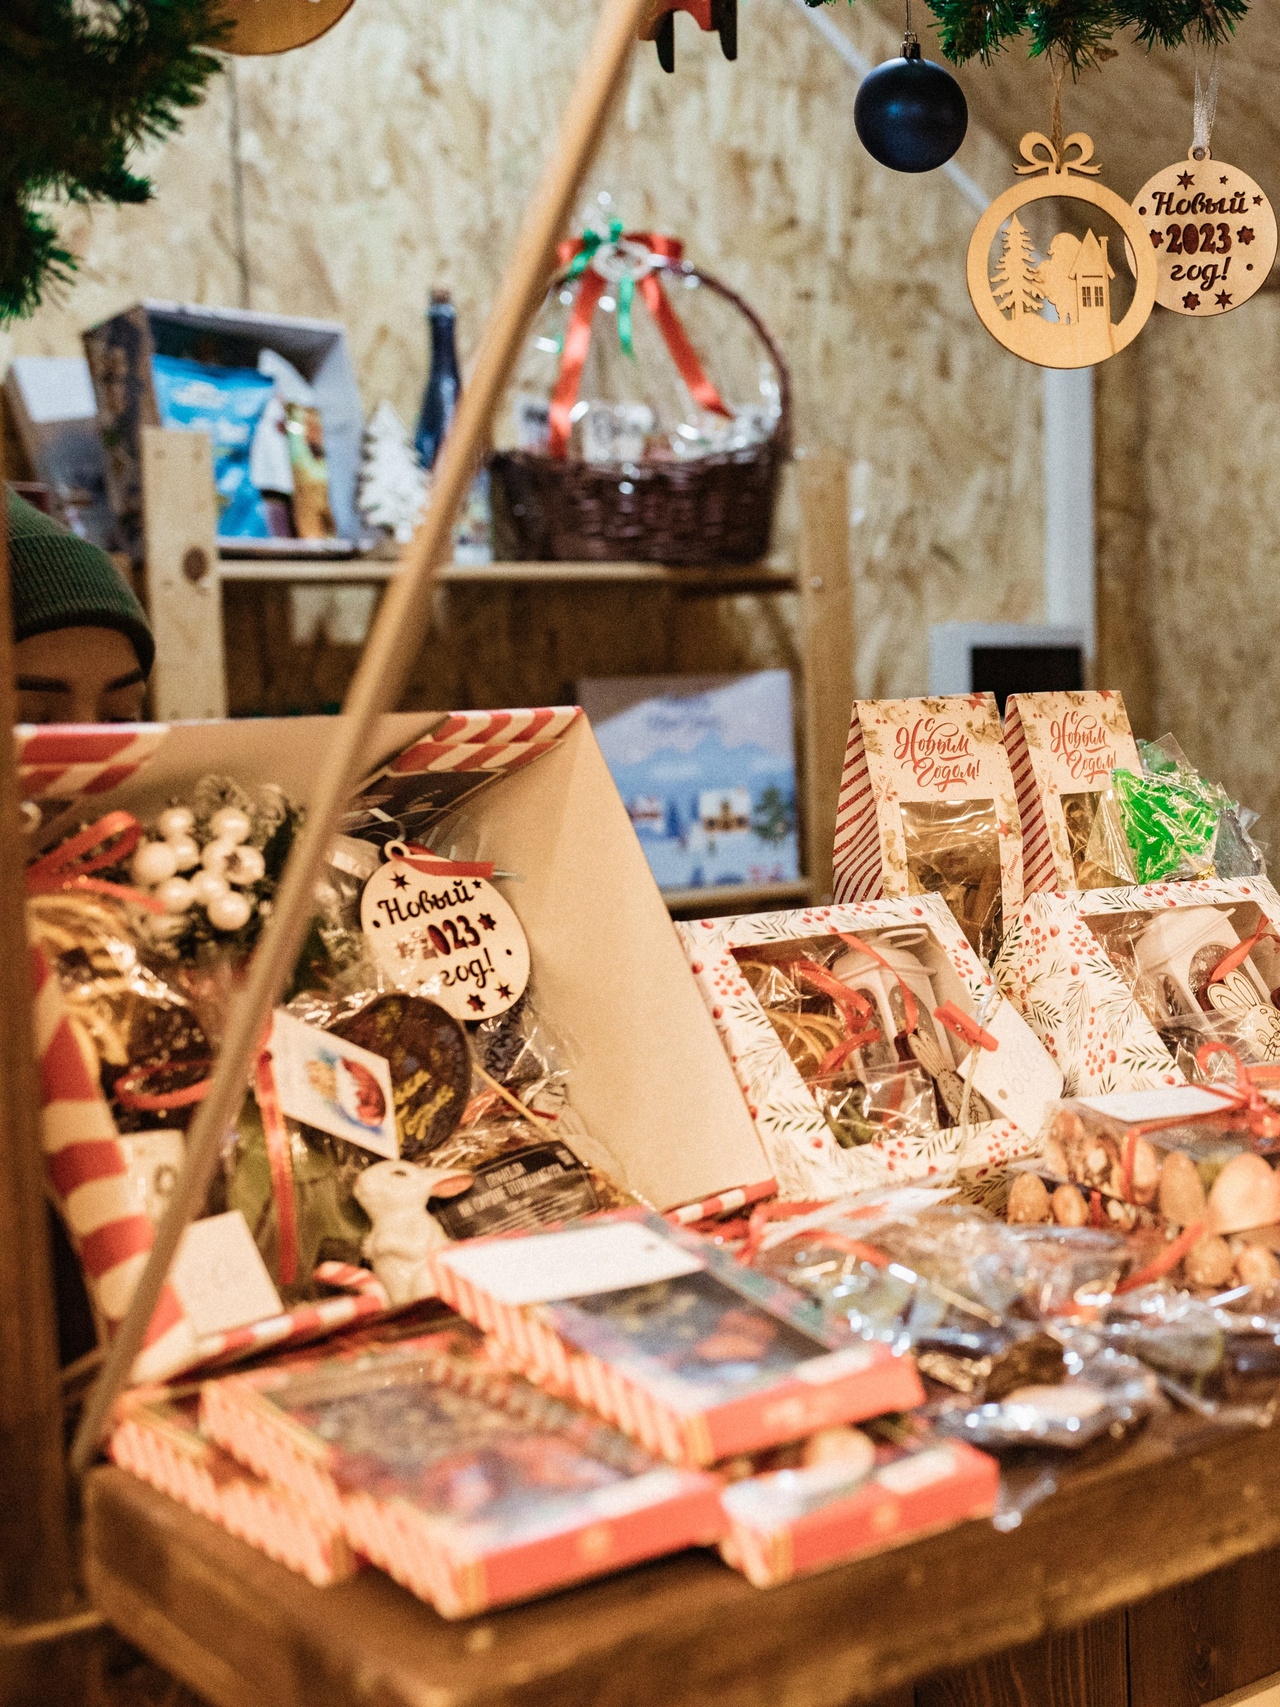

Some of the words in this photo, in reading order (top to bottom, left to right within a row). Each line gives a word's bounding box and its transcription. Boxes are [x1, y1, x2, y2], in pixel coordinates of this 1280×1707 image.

[1152, 191, 1249, 216] Новый
[1166, 222, 1232, 255] 2023
[1170, 256, 1232, 292] год!
[924, 717, 936, 732] С
[1050, 711, 1112, 767] Новым
[893, 718, 975, 775] Новым
[900, 757, 981, 793] Годом!
[377, 879, 475, 926] Новый
[440, 946, 496, 989] год!
